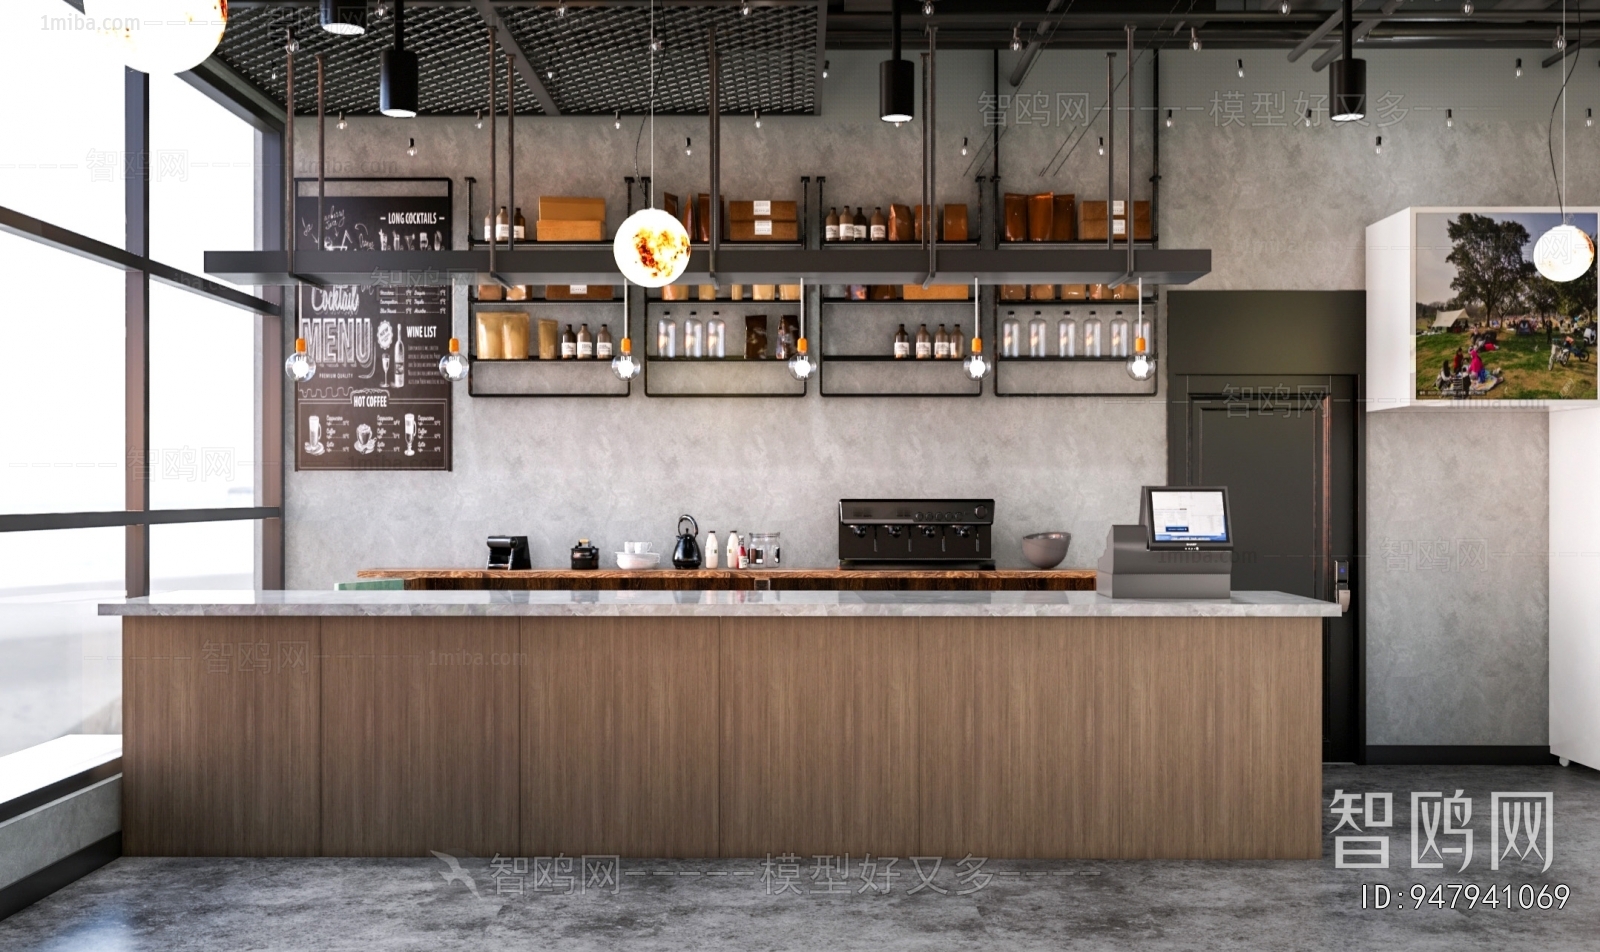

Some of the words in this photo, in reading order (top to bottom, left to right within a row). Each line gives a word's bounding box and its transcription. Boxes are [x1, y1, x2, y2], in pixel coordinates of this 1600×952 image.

[388, 212, 404, 224] LONG
[405, 212, 437, 224] COCKTAILS
[406, 326, 423, 338] WINE
[424, 326, 437, 338] LIST
[302, 318, 371, 365] MENU
[353, 396, 366, 408] HOT
[366, 396, 388, 408] COFFEE
